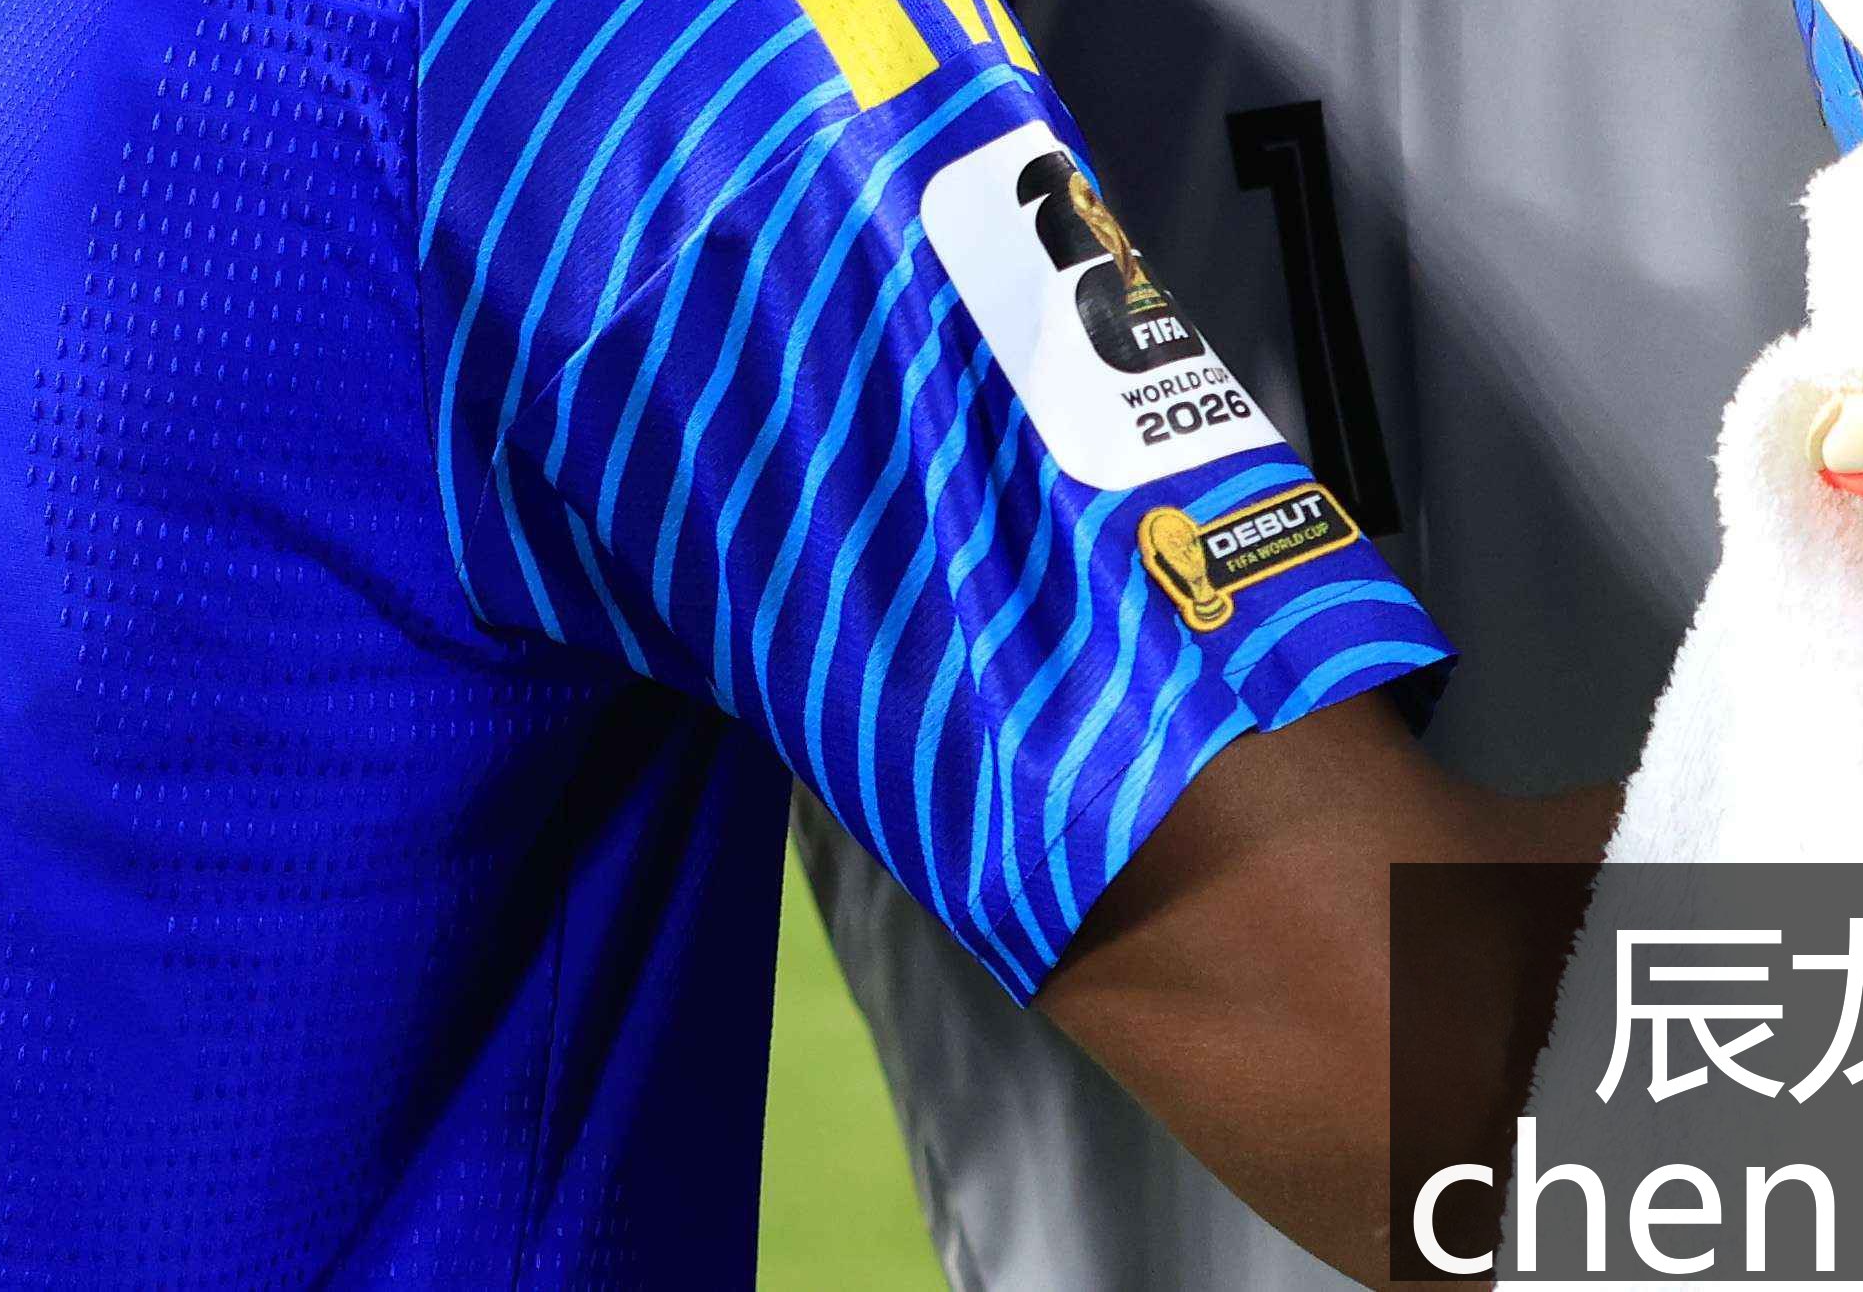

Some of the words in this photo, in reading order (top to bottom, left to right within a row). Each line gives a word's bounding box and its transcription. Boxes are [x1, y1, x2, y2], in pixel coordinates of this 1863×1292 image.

[1131, 315, 1189, 350] FIFA
[1226, 100, 1402, 539] 1
[1120, 369, 1202, 410] WORLD
[1203, 364, 1232, 389] CUP
[1135, 389, 1252, 448] 2026
[1206, 493, 1325, 560] DEBUT
[1225, 544, 1259, 573] FIFA
[1255, 530, 1304, 562] WORLD
[1302, 521, 1331, 549] CUP
